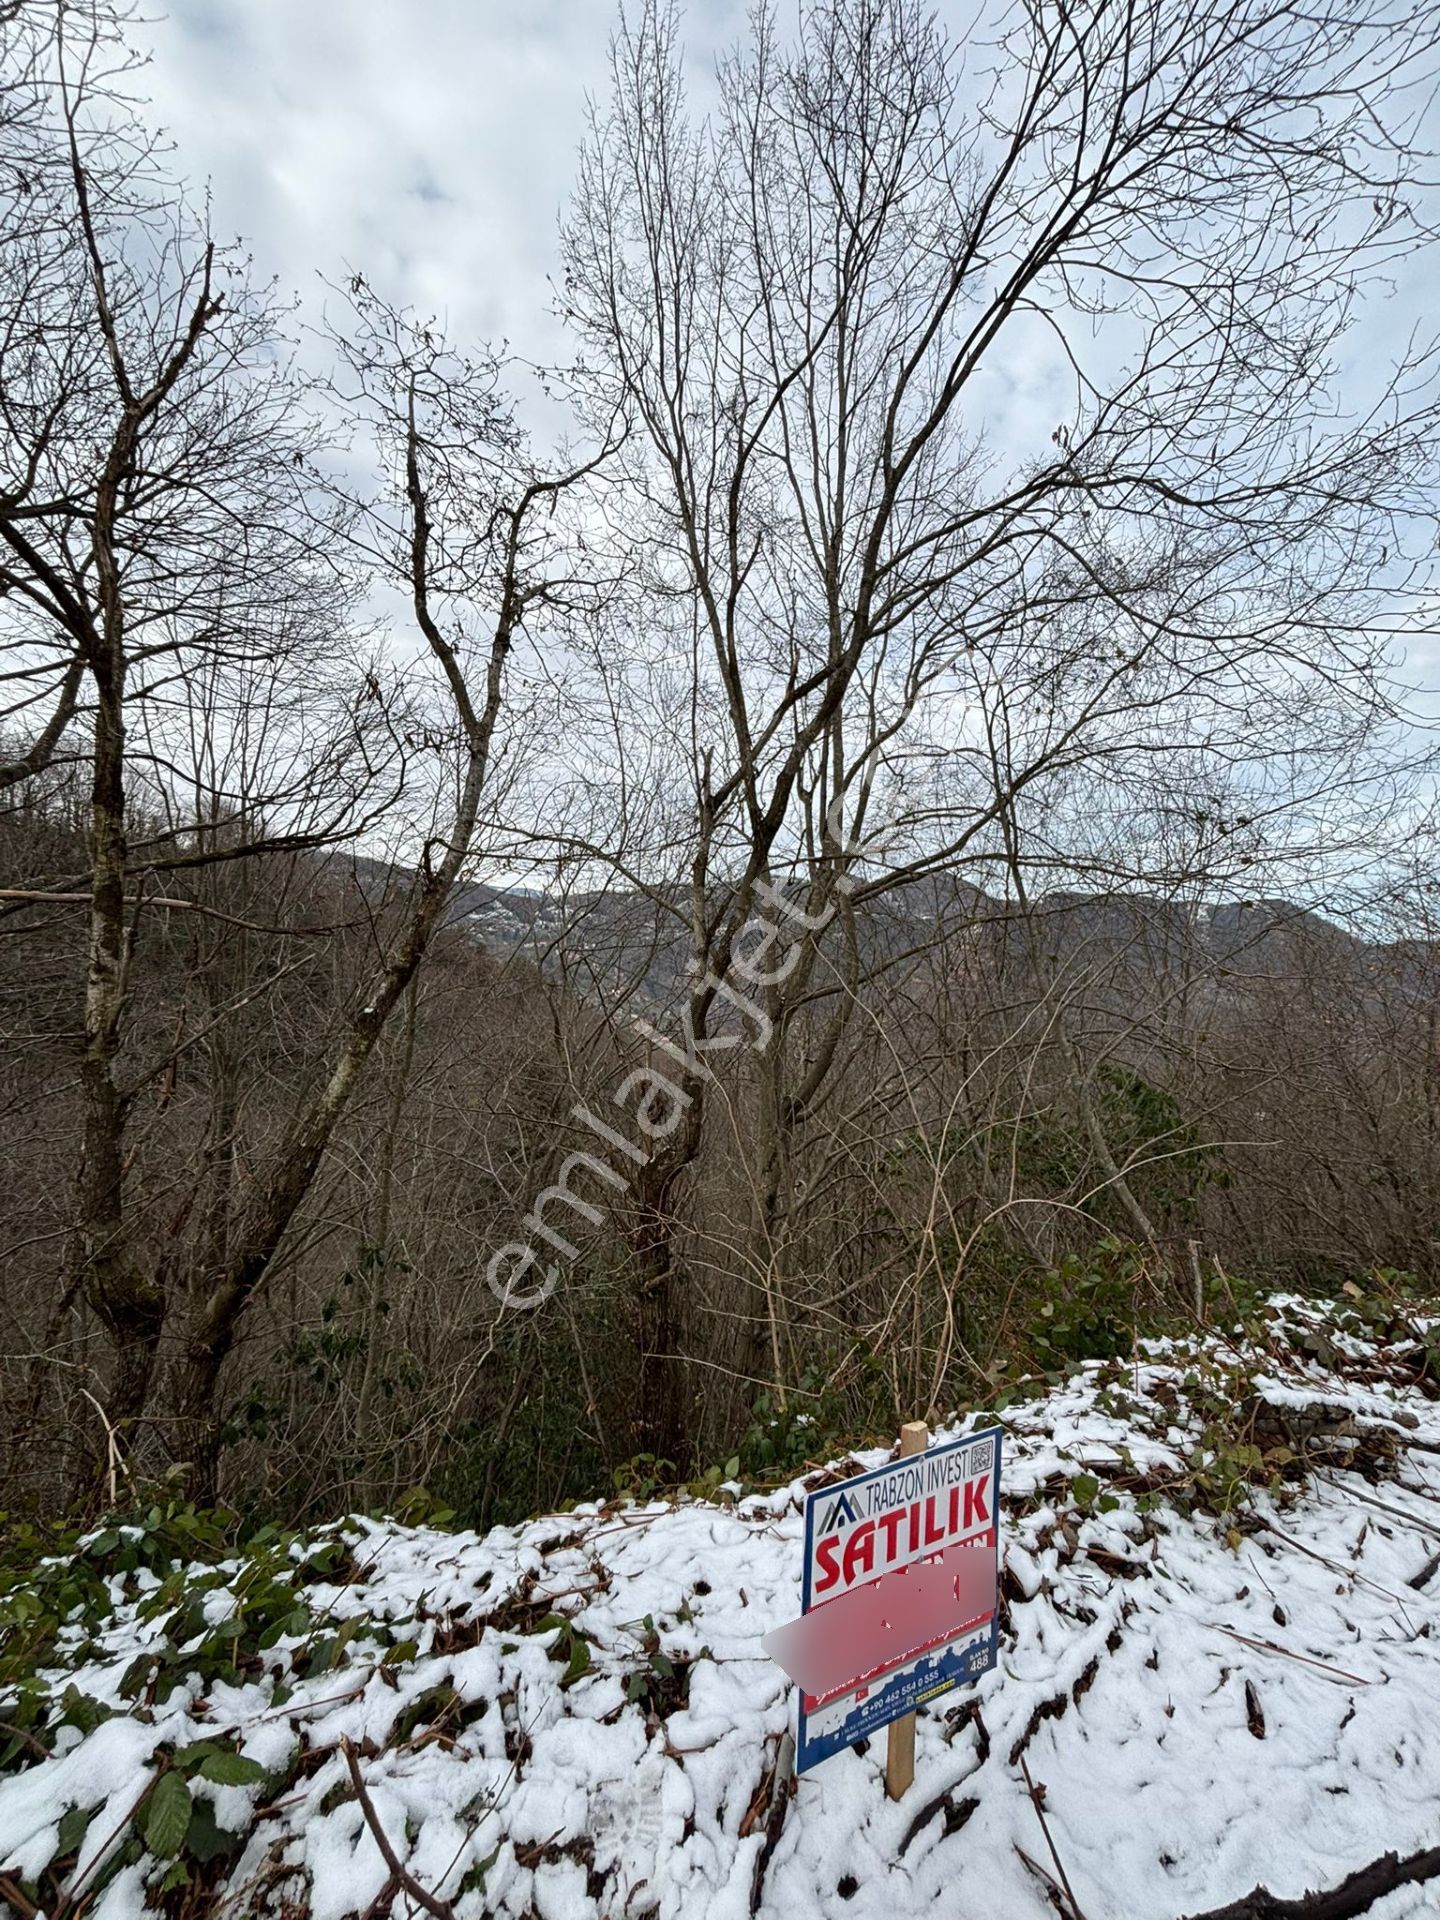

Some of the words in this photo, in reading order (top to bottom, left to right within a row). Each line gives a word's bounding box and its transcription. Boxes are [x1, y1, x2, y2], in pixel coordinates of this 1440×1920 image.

[866, 1465, 923, 1516] TRABZON
[927, 1449, 968, 1492] INVEST
[815, 1474, 990, 1594] SATILIK
[970, 1655, 989, 1672] 488
